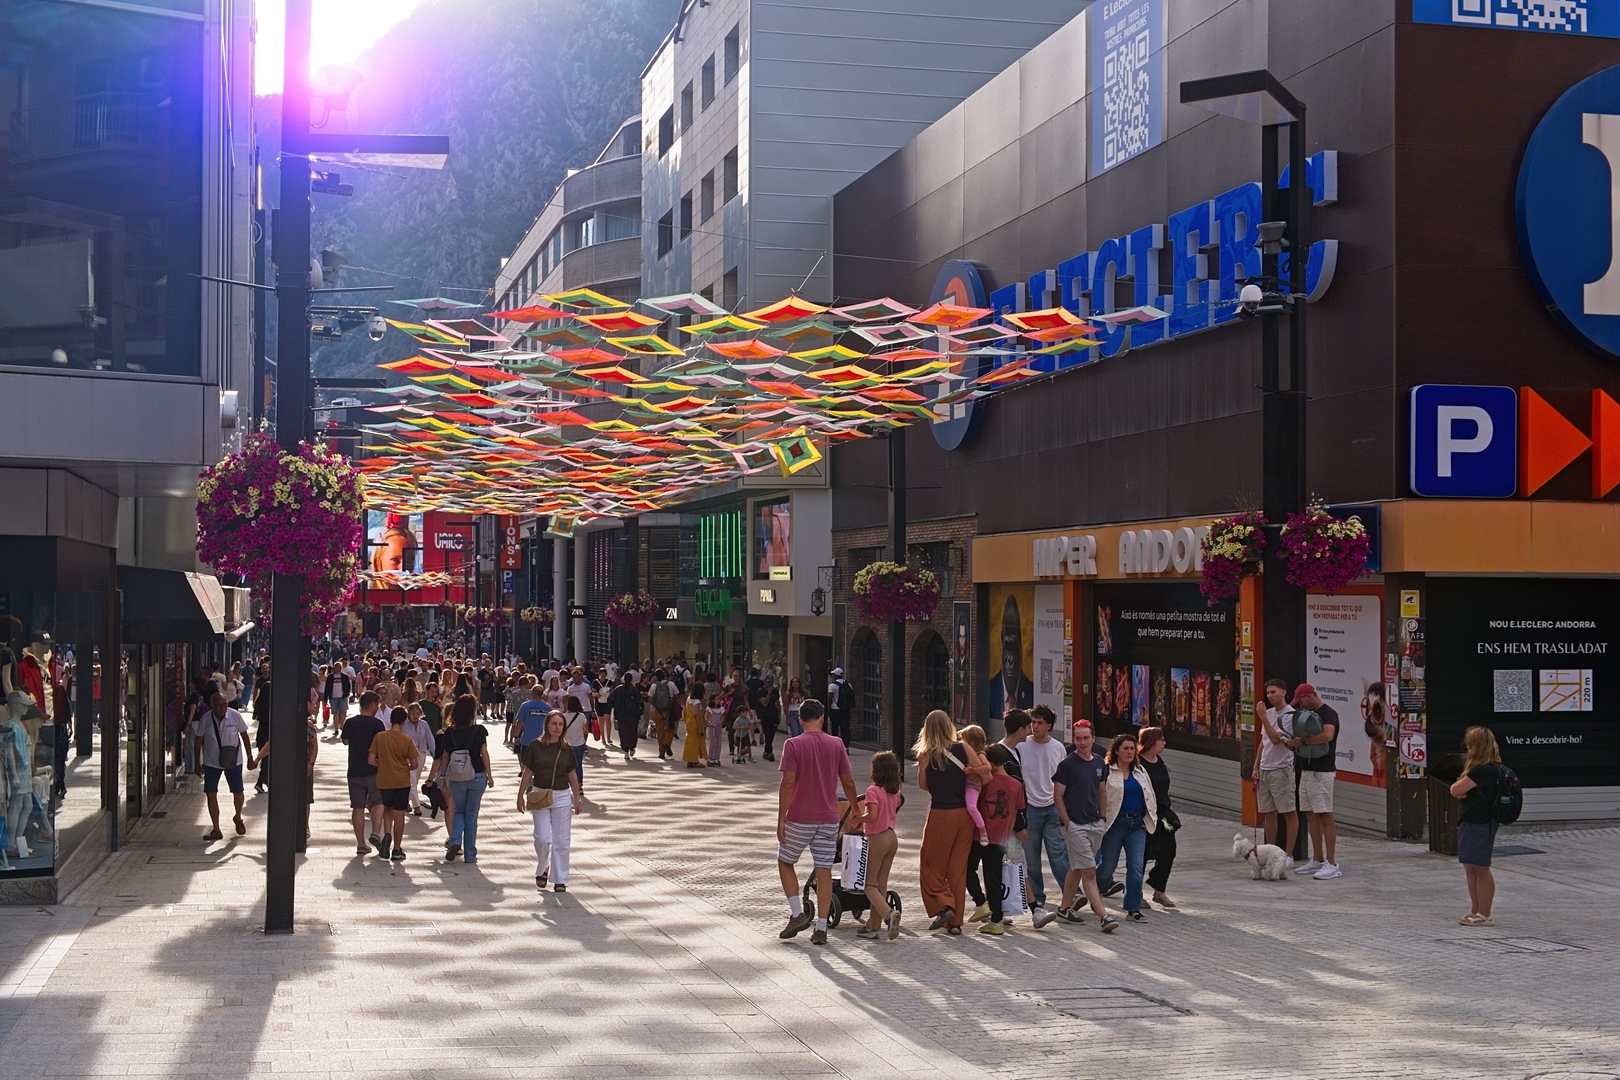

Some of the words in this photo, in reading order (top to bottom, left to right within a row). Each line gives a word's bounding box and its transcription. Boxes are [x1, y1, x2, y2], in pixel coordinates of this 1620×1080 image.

[1142, 2, 1150, 16] LES
[1437, 405, 1493, 477] P
[1033, 535, 1098, 577] HIPER
[1132, 609, 1138, 620] és
[1139, 610, 1155, 620] només
[1167, 610, 1182, 622] petita
[1183, 612, 1202, 621] mostra
[1203, 611, 1210, 622] de
[1211, 612, 1220, 622] tot
[1220, 612, 1226, 622] el
[1138, 628, 1147, 638] que
[1148, 626, 1159, 636] hem
[1160, 629, 1183, 639] preparat
[1184, 630, 1193, 640] per
[1477, 643, 1500, 654] ENS
[1504, 643, 1531, 654] HEM
[1534, 643, 1608, 654] TRASLLADAT
[1506, 736, 1523, 744] Vine
[1532, 735, 1582, 744] descobrir-ho!
[854, 836, 868, 890] Viladomat
